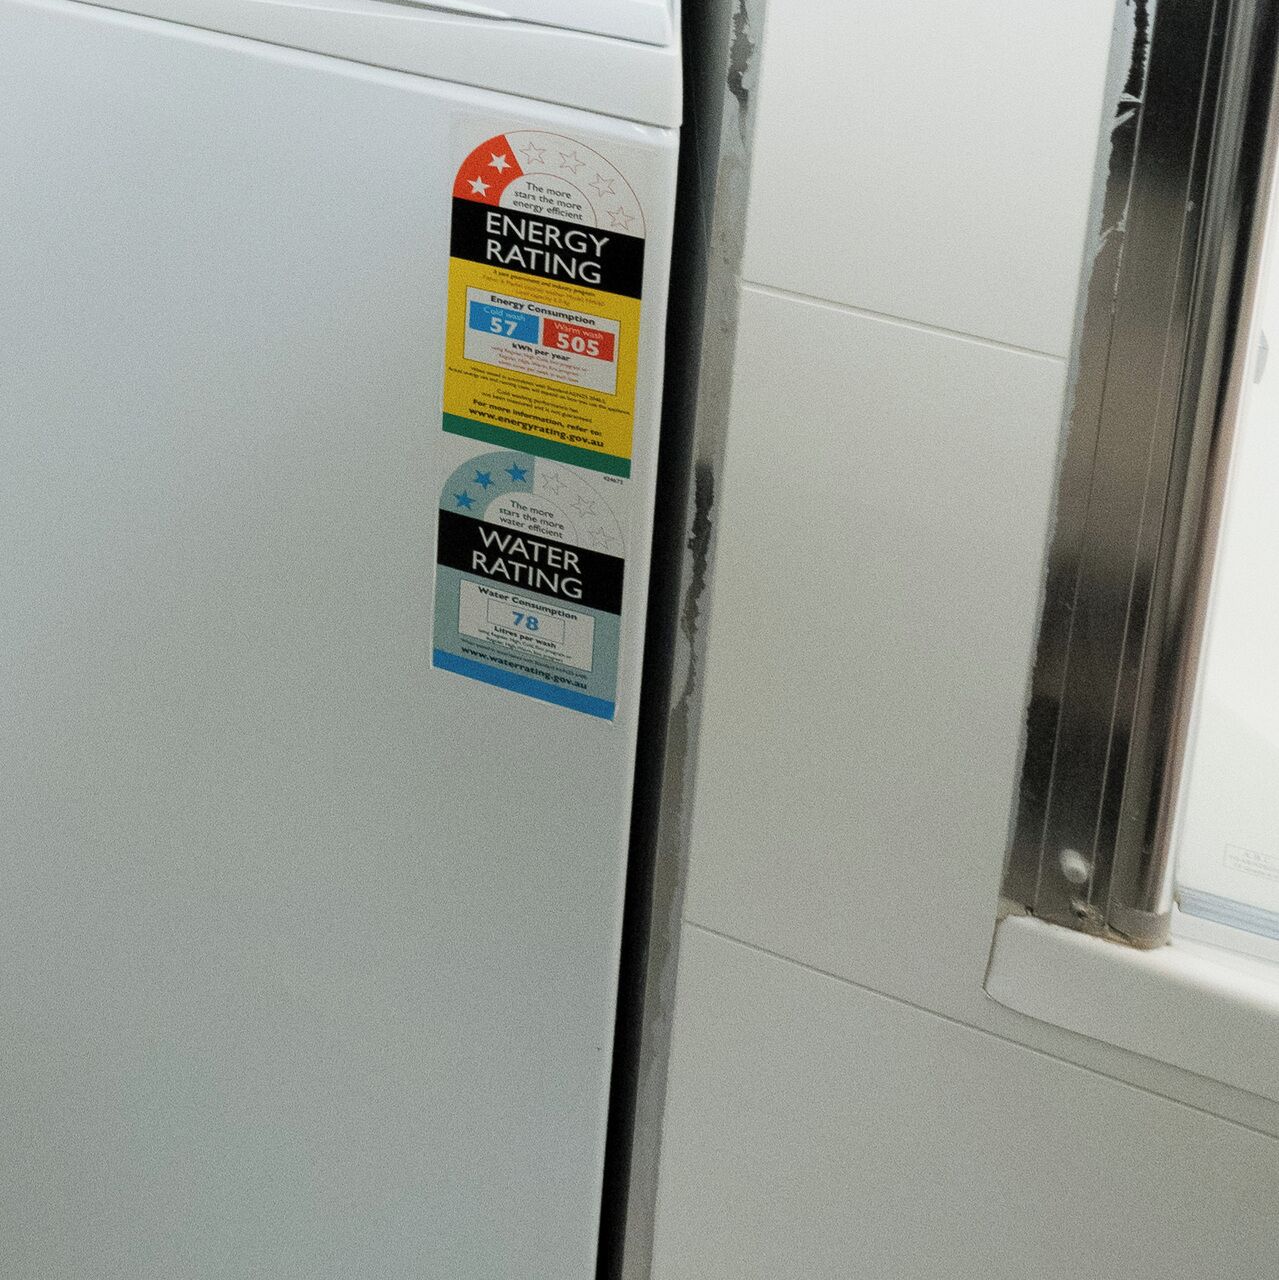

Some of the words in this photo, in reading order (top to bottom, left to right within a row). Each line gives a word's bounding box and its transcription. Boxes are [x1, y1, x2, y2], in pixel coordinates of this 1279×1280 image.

[514, 191, 536, 201] stars
[540, 194, 554, 204] the
[557, 200, 582, 210] more
[526, 182, 542, 192] The
[546, 188, 571, 199] more
[513, 200, 543, 213] energy
[546, 206, 582, 220] efficient
[486, 211, 609, 257] ENERGY
[486, 238, 601, 284] RATING
[484, 306, 504, 315] Cold
[506, 312, 526, 322] wash
[491, 296, 524, 310] Energy
[528, 304, 596, 325] Consumption
[490, 317, 518, 336] 57
[554, 322, 580, 335] Warm
[582, 330, 604, 340] wash
[512, 342, 532, 353] kWh
[535, 348, 549, 357] per
[551, 352, 570, 362] year
[557, 332, 600, 356] 505
[473, 398, 486, 407] For
[489, 403, 511, 412] more
[513, 408, 564, 428] information,
[566, 422, 589, 432] refer
[469, 408, 604, 447] www.energyrating.gov.au
[500, 508, 520, 519] stars
[523, 512, 537, 522] the
[540, 519, 564, 530] more
[510, 500, 528, 511] The
[530, 507, 554, 518] more
[500, 517, 525, 528] water
[528, 522, 563, 538] efficient
[478, 526, 582, 574] WATER
[472, 550, 582, 599] RATING
[478, 586, 509, 601] Water
[512, 596, 578, 620] Consumption
[511, 611, 539, 631] 78
[494, 626, 517, 638] Litres
[519, 633, 534, 642] per
[536, 637, 556, 649] wash
[461, 647, 587, 690] www.waterrating.gov.au
